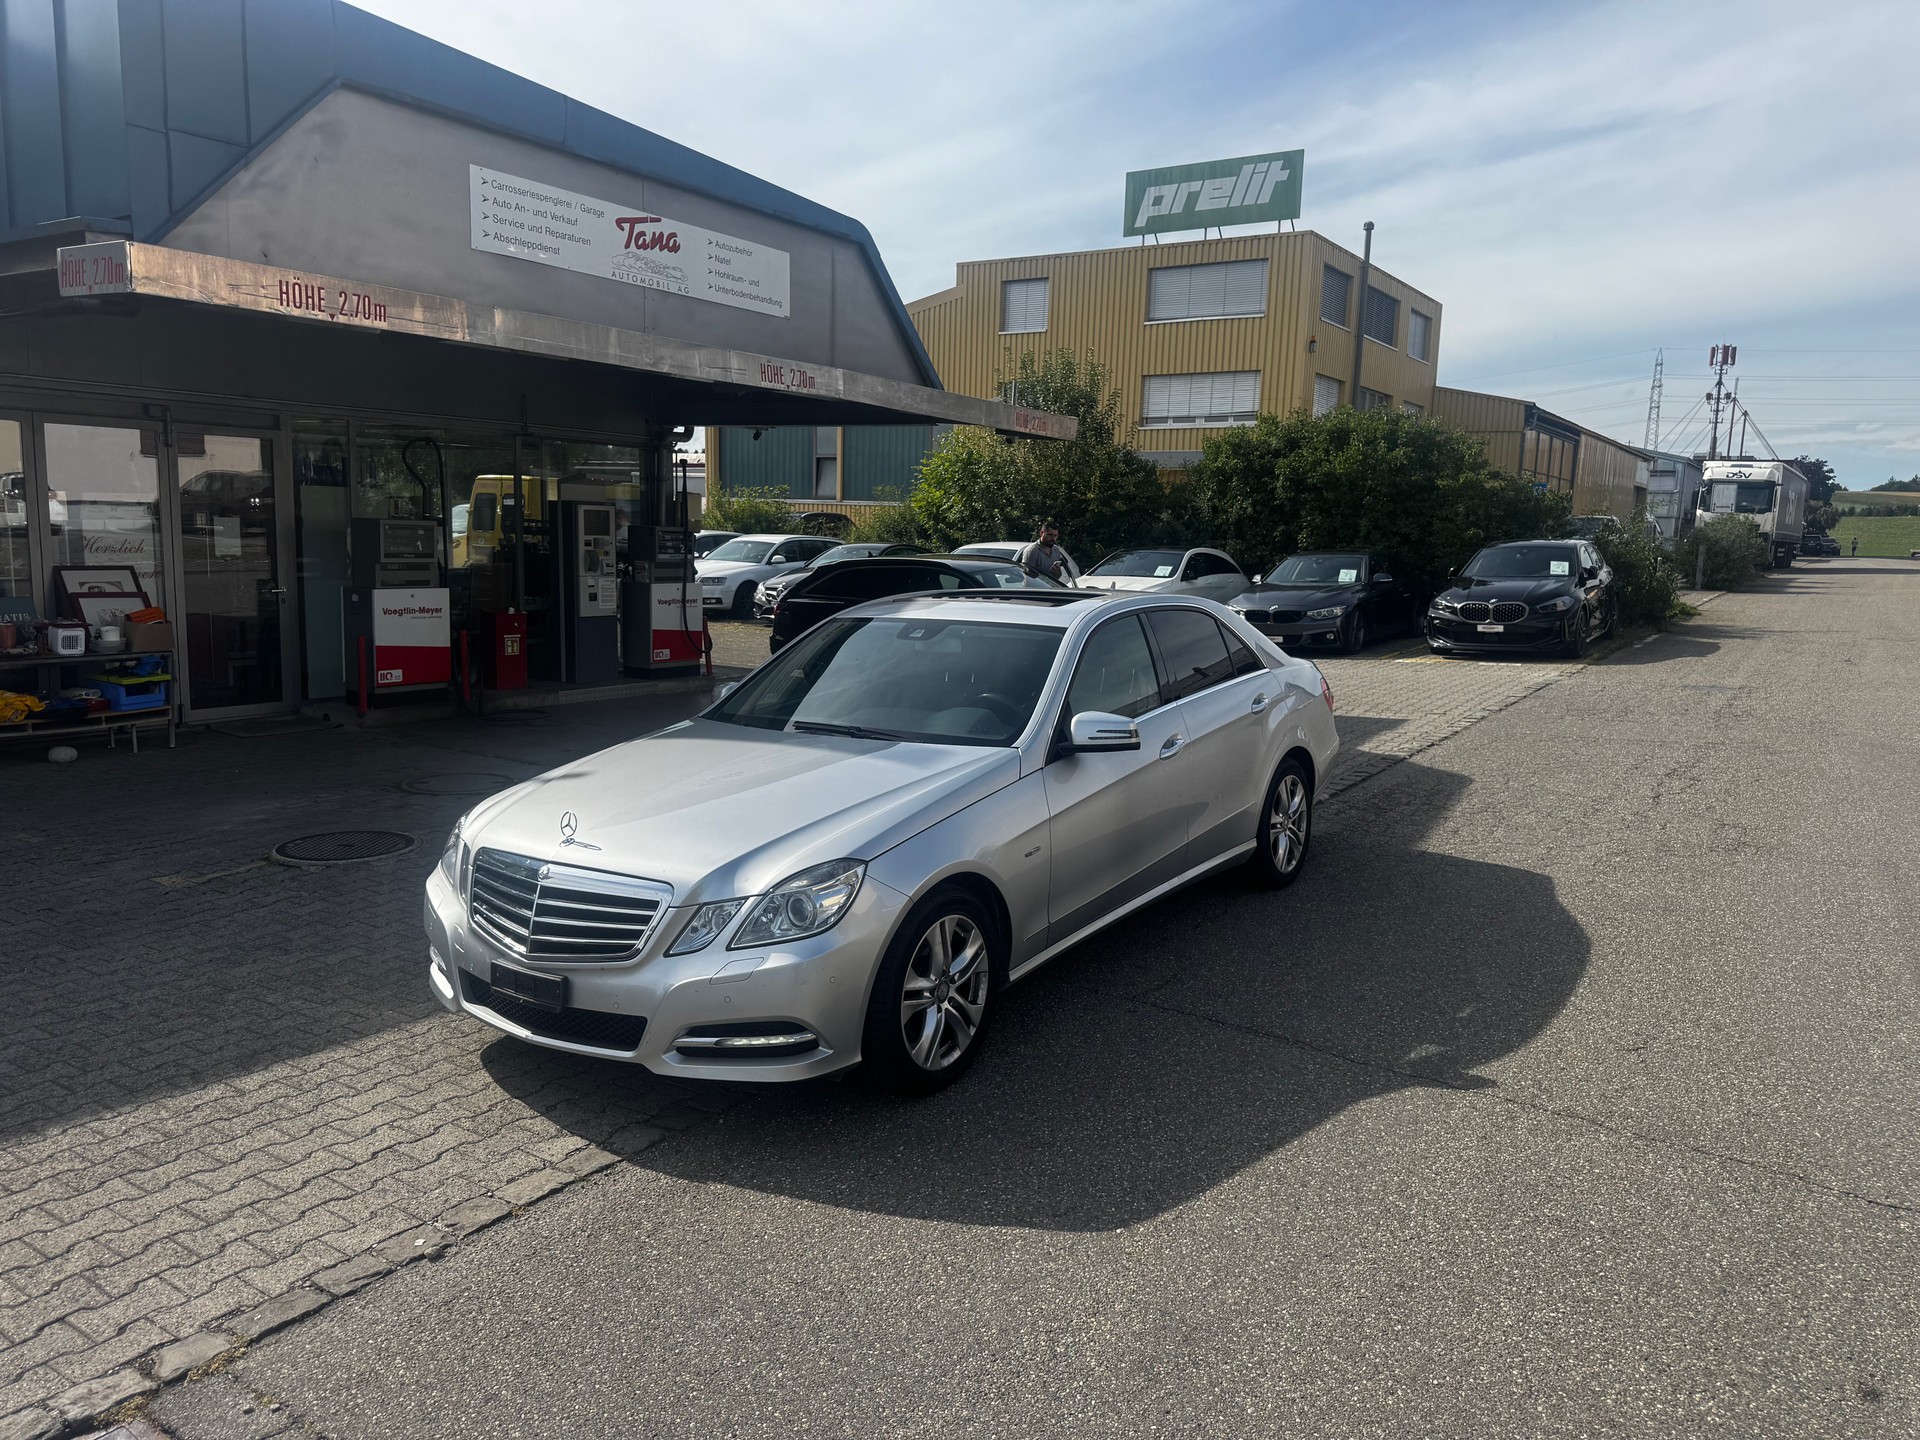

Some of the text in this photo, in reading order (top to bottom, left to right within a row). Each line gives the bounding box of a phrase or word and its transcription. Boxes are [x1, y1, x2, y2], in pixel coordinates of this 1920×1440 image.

[490, 179, 573, 209] Carrosseriespenglerei
[580, 203, 605, 218] Garage
[1134, 160, 1290, 228] prelit
[492, 197, 578, 226] Auto An- und Verkauf
[492, 214, 591, 246] Service und Reparaturen
[615, 215, 681, 254] Tana
[493, 232, 560, 255] Abschleppdienst
[715, 240, 753, 257] Autozubehör
[61, 254, 87, 289] HÖHE
[714, 254, 731, 266] Natel
[611, 271, 690, 295] AUTOMOBIL AG
[714, 269, 760, 288] Hohlraum- und
[279, 276, 387, 322] HÖHE 2.70m
[714, 284, 783, 309] Unterbodenbehandlung
[760, 360, 785, 385] HÖHE
[1726, 470, 1753, 479] DSV
[82, 535, 146, 554] Herzlich
[416, 540, 423, 551] 1
[680, 544, 686, 553] 2
[382, 606, 443, 617] Voegtlin-Meyer
[657, 598, 698, 606] Voegtlin-eyer
